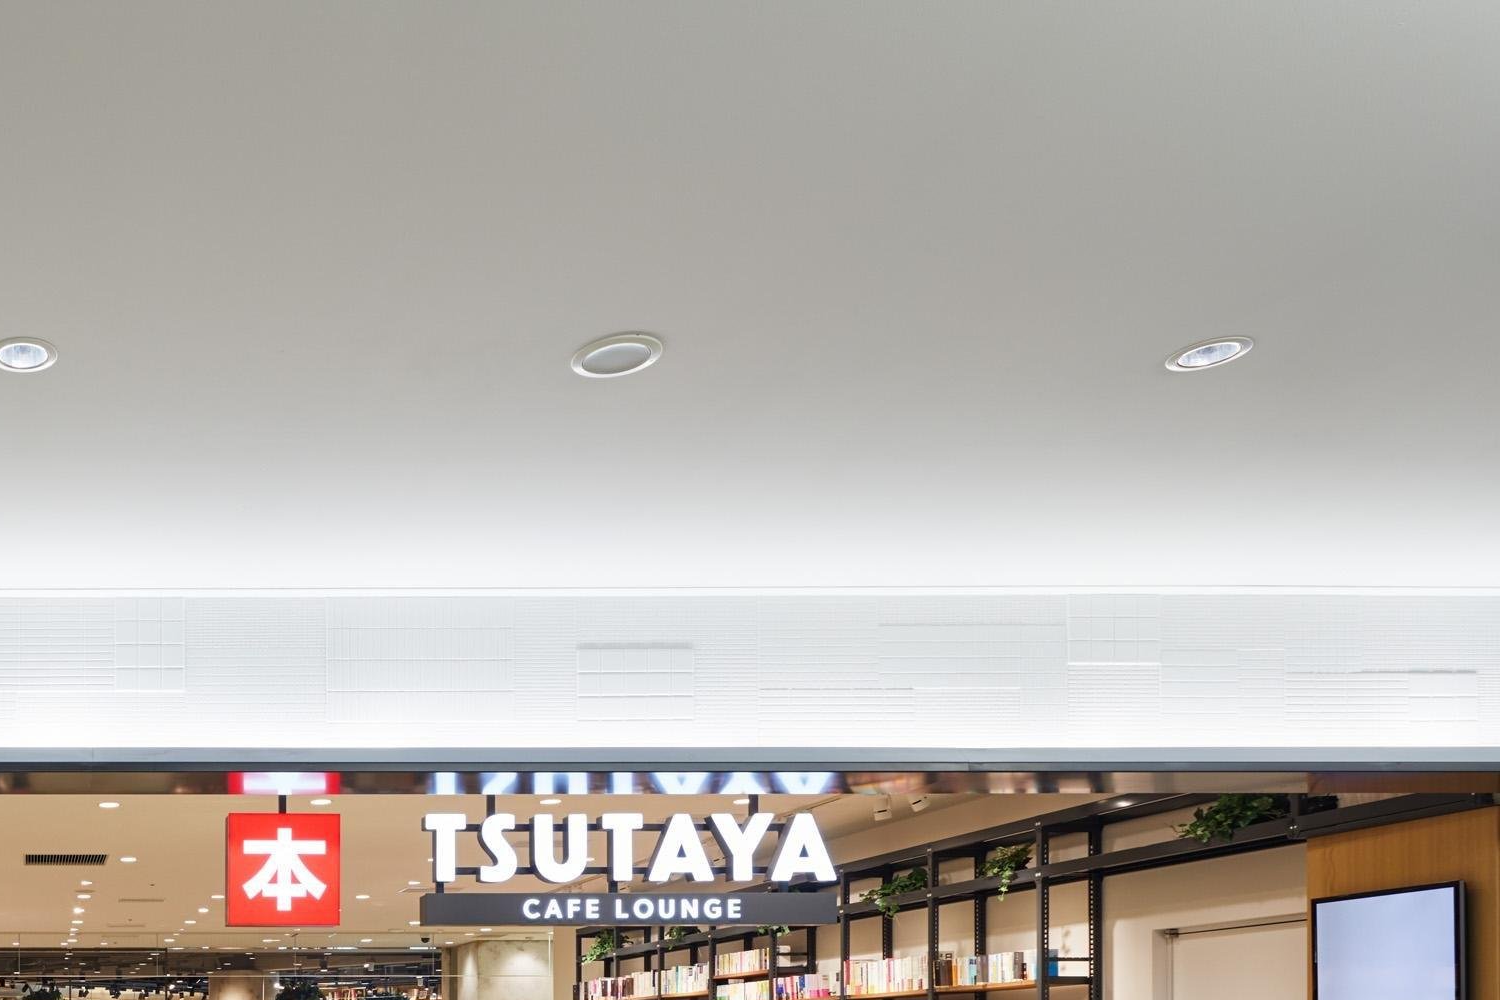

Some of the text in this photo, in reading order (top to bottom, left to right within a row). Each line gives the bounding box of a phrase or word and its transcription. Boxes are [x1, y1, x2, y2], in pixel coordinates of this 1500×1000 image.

[242, 827, 328, 912] 本
[425, 812, 837, 883] TSUTAYA
[522, 898, 742, 920] CAFE LOUNGE
